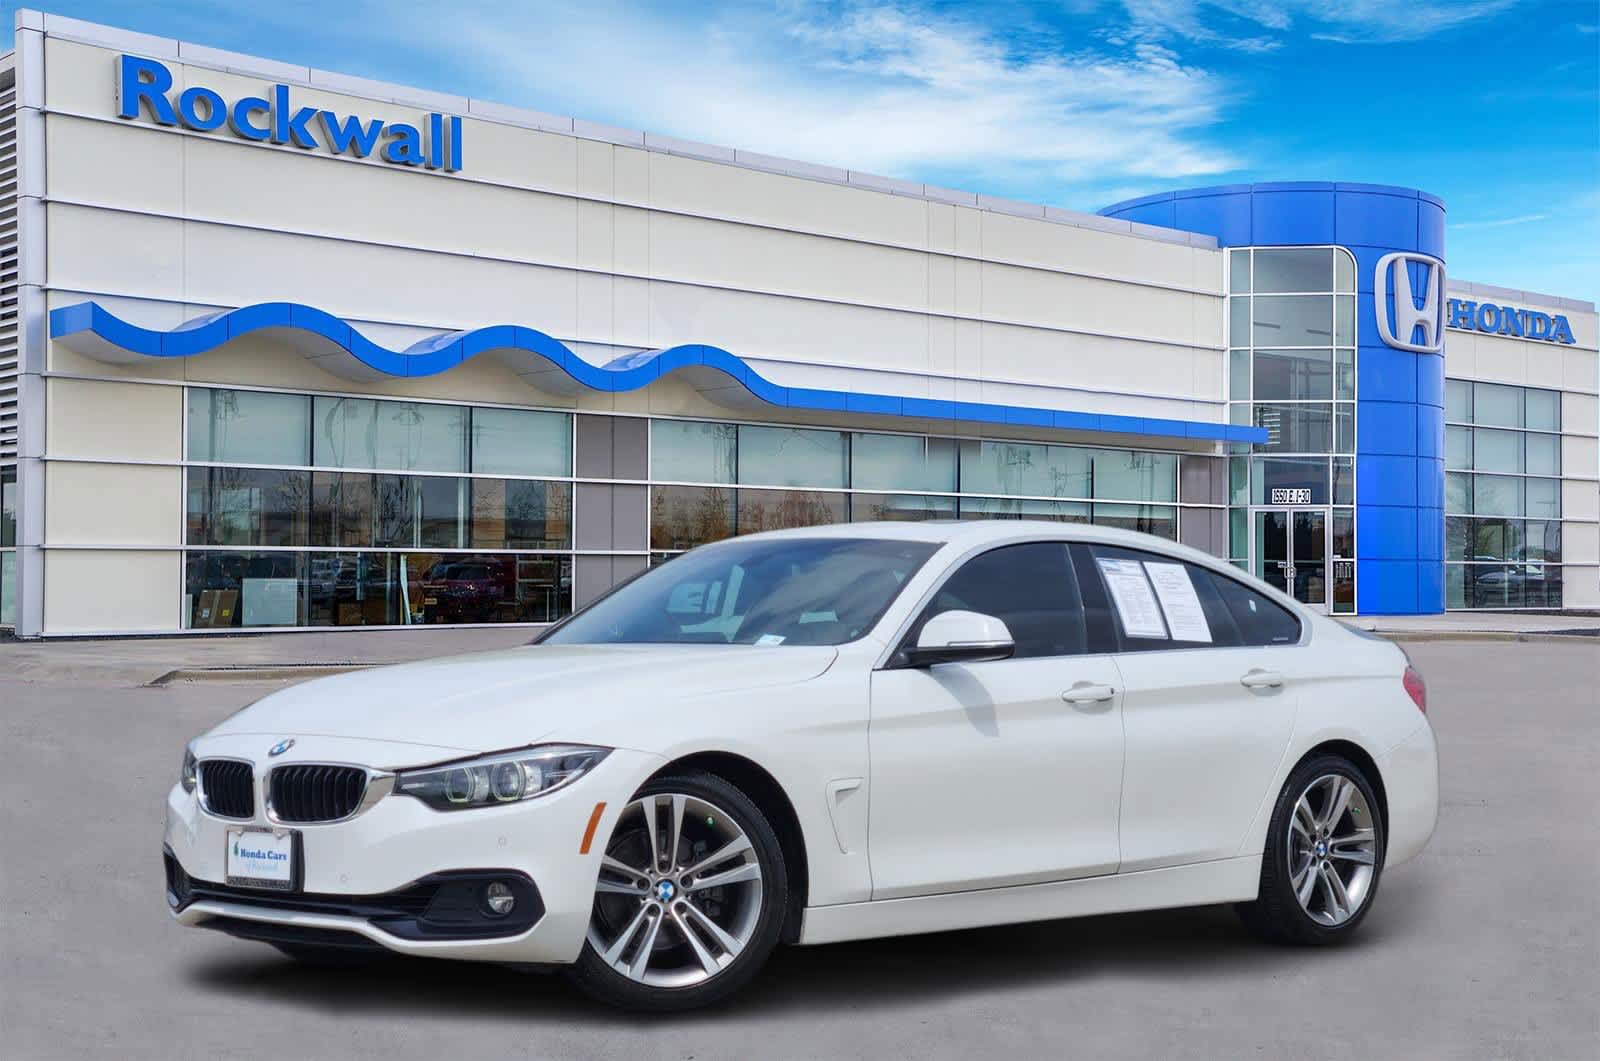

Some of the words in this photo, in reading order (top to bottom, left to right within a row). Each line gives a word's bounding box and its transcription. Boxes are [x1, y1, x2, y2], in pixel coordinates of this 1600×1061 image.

[115, 54, 464, 172] Rockwall
[1447, 299, 1576, 344] HONDA
[1273, 489, 1288, 503] 1550
[240, 848, 266, 860] Honda
[267, 850, 288, 861] Cars
